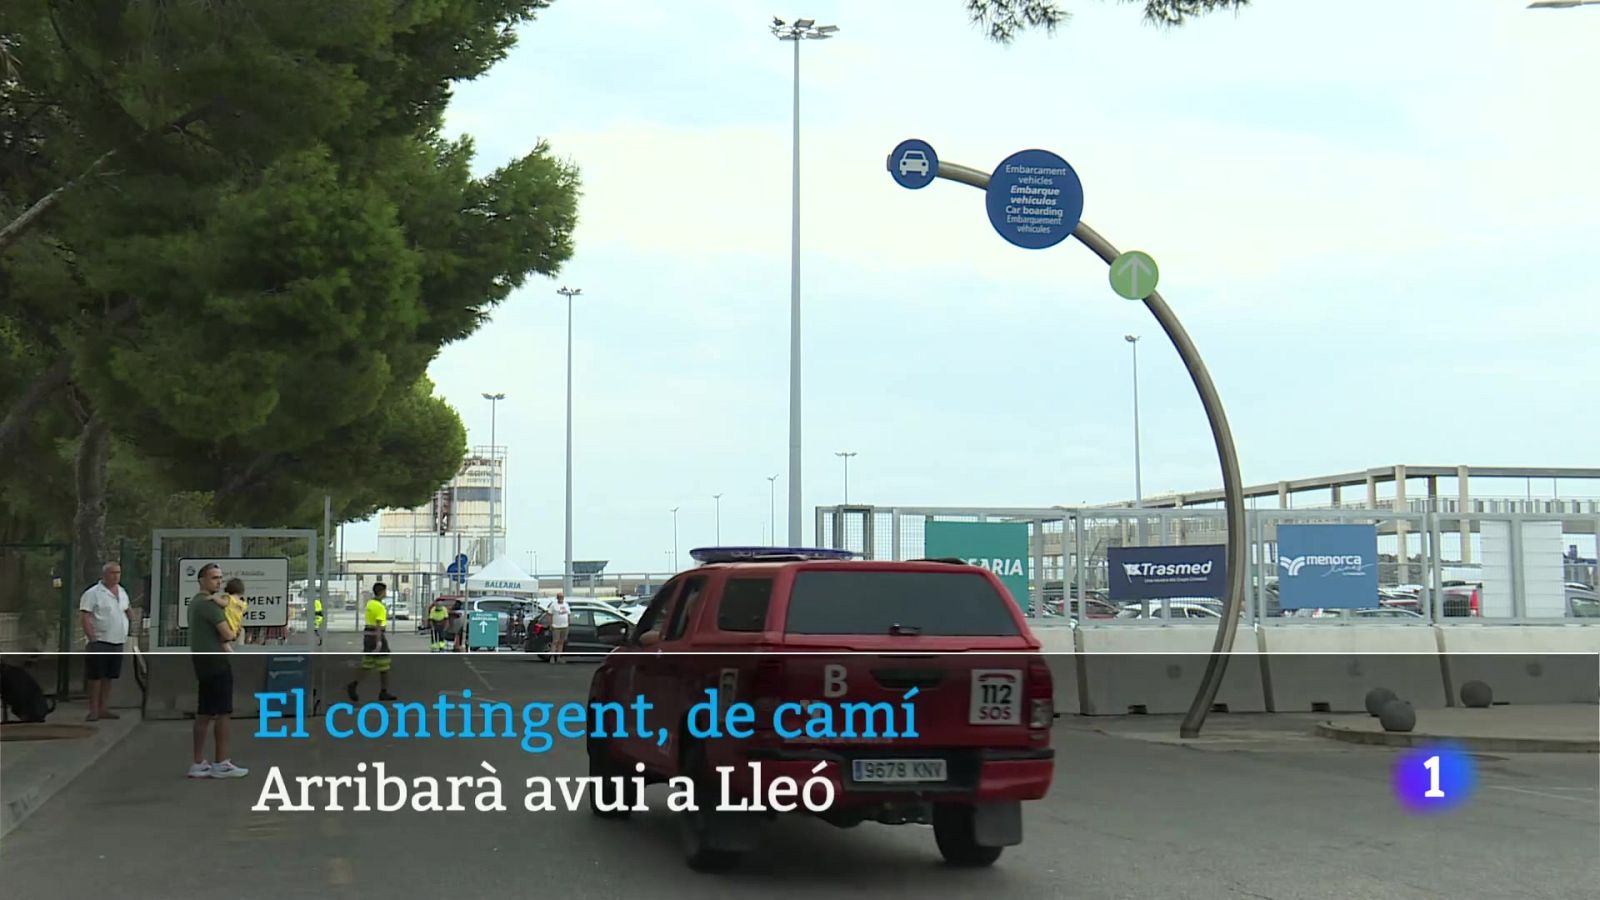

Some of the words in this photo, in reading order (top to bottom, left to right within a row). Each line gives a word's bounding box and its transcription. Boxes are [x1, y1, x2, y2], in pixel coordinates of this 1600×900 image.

[1005, 164, 1067, 176] Embarcament
[1018, 175, 1053, 185] vehicles
[1010, 185, 1060, 197] Embarque
[1005, 205, 1021, 214] Car
[1023, 206, 1064, 217] boarding
[1306, 555, 1362, 565] menorca
[1141, 560, 1213, 576] Trasmed
[824, 664, 849, 698] B
[981, 684, 1012, 704] 112
[978, 705, 1012, 720] SOS
